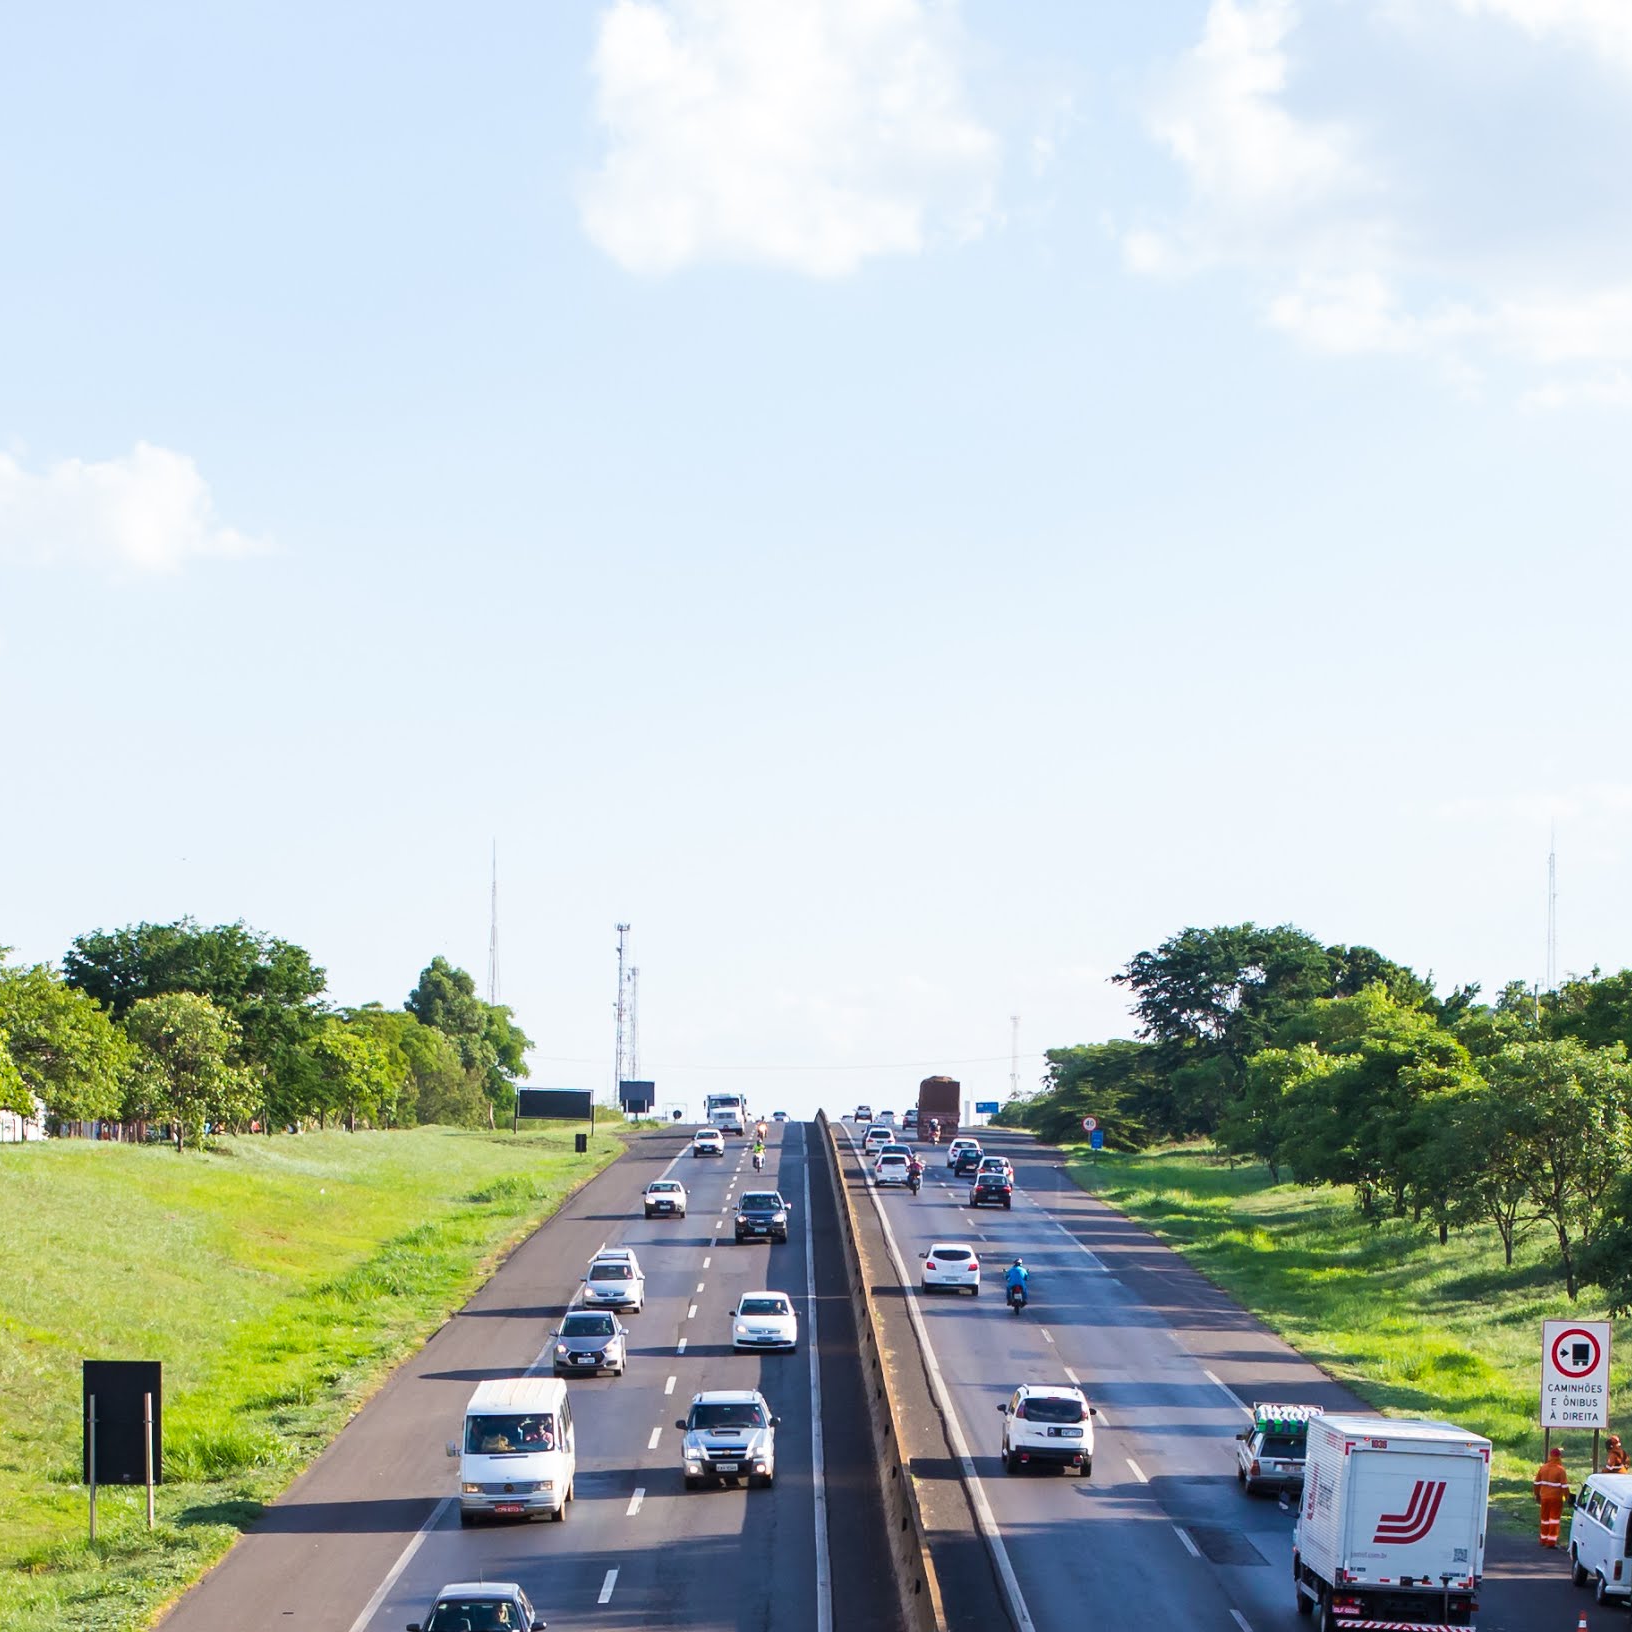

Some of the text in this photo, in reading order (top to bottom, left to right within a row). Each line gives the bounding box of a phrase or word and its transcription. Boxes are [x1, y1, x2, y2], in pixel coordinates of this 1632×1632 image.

[1548, 1383, 1603, 1393] CAMINHÕES
[1551, 1395, 1598, 1407] E ÔNIBUS
[1550, 1410, 1599, 1421] À DIREITA
